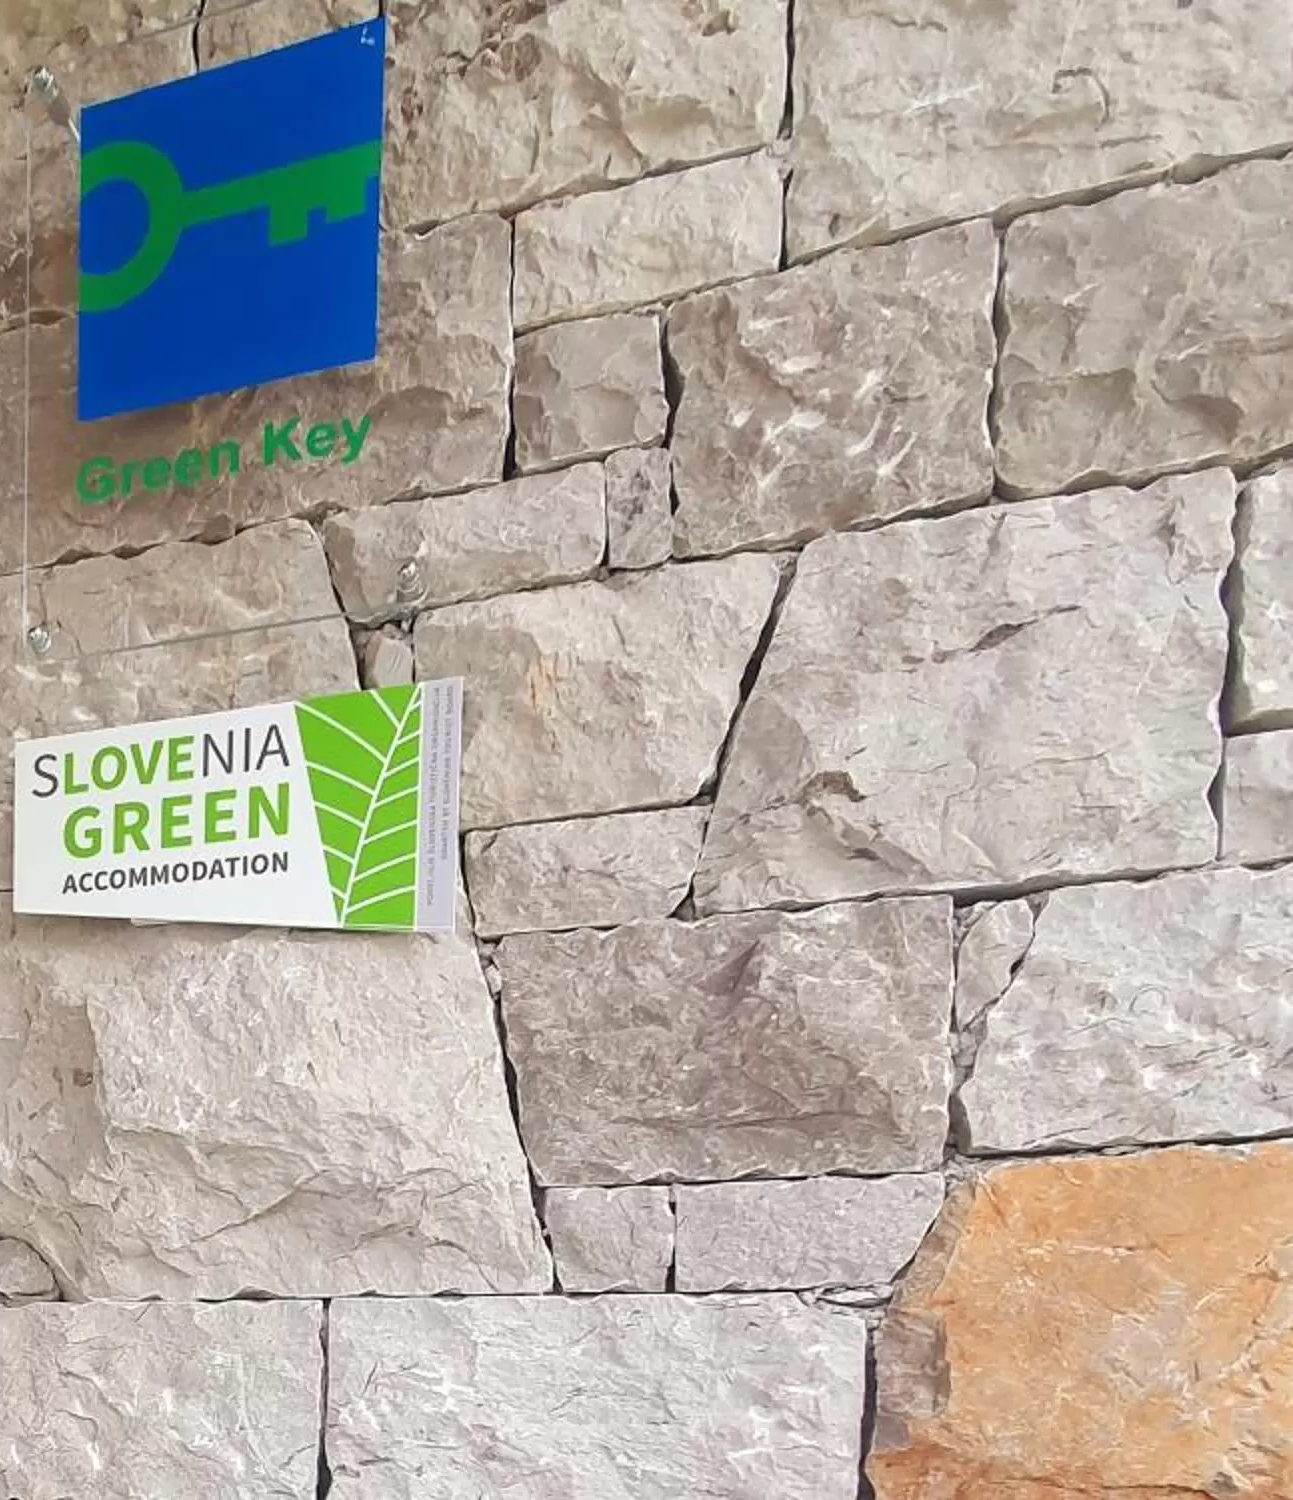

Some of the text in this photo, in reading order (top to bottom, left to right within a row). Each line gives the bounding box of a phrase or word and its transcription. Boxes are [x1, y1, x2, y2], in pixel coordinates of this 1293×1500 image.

[75, 414, 373, 505] Green Key
[31, 723, 291, 798] SLOVENIA
[62, 782, 290, 859] GREEN
[62, 851, 289, 894] ACCOMMODATION
